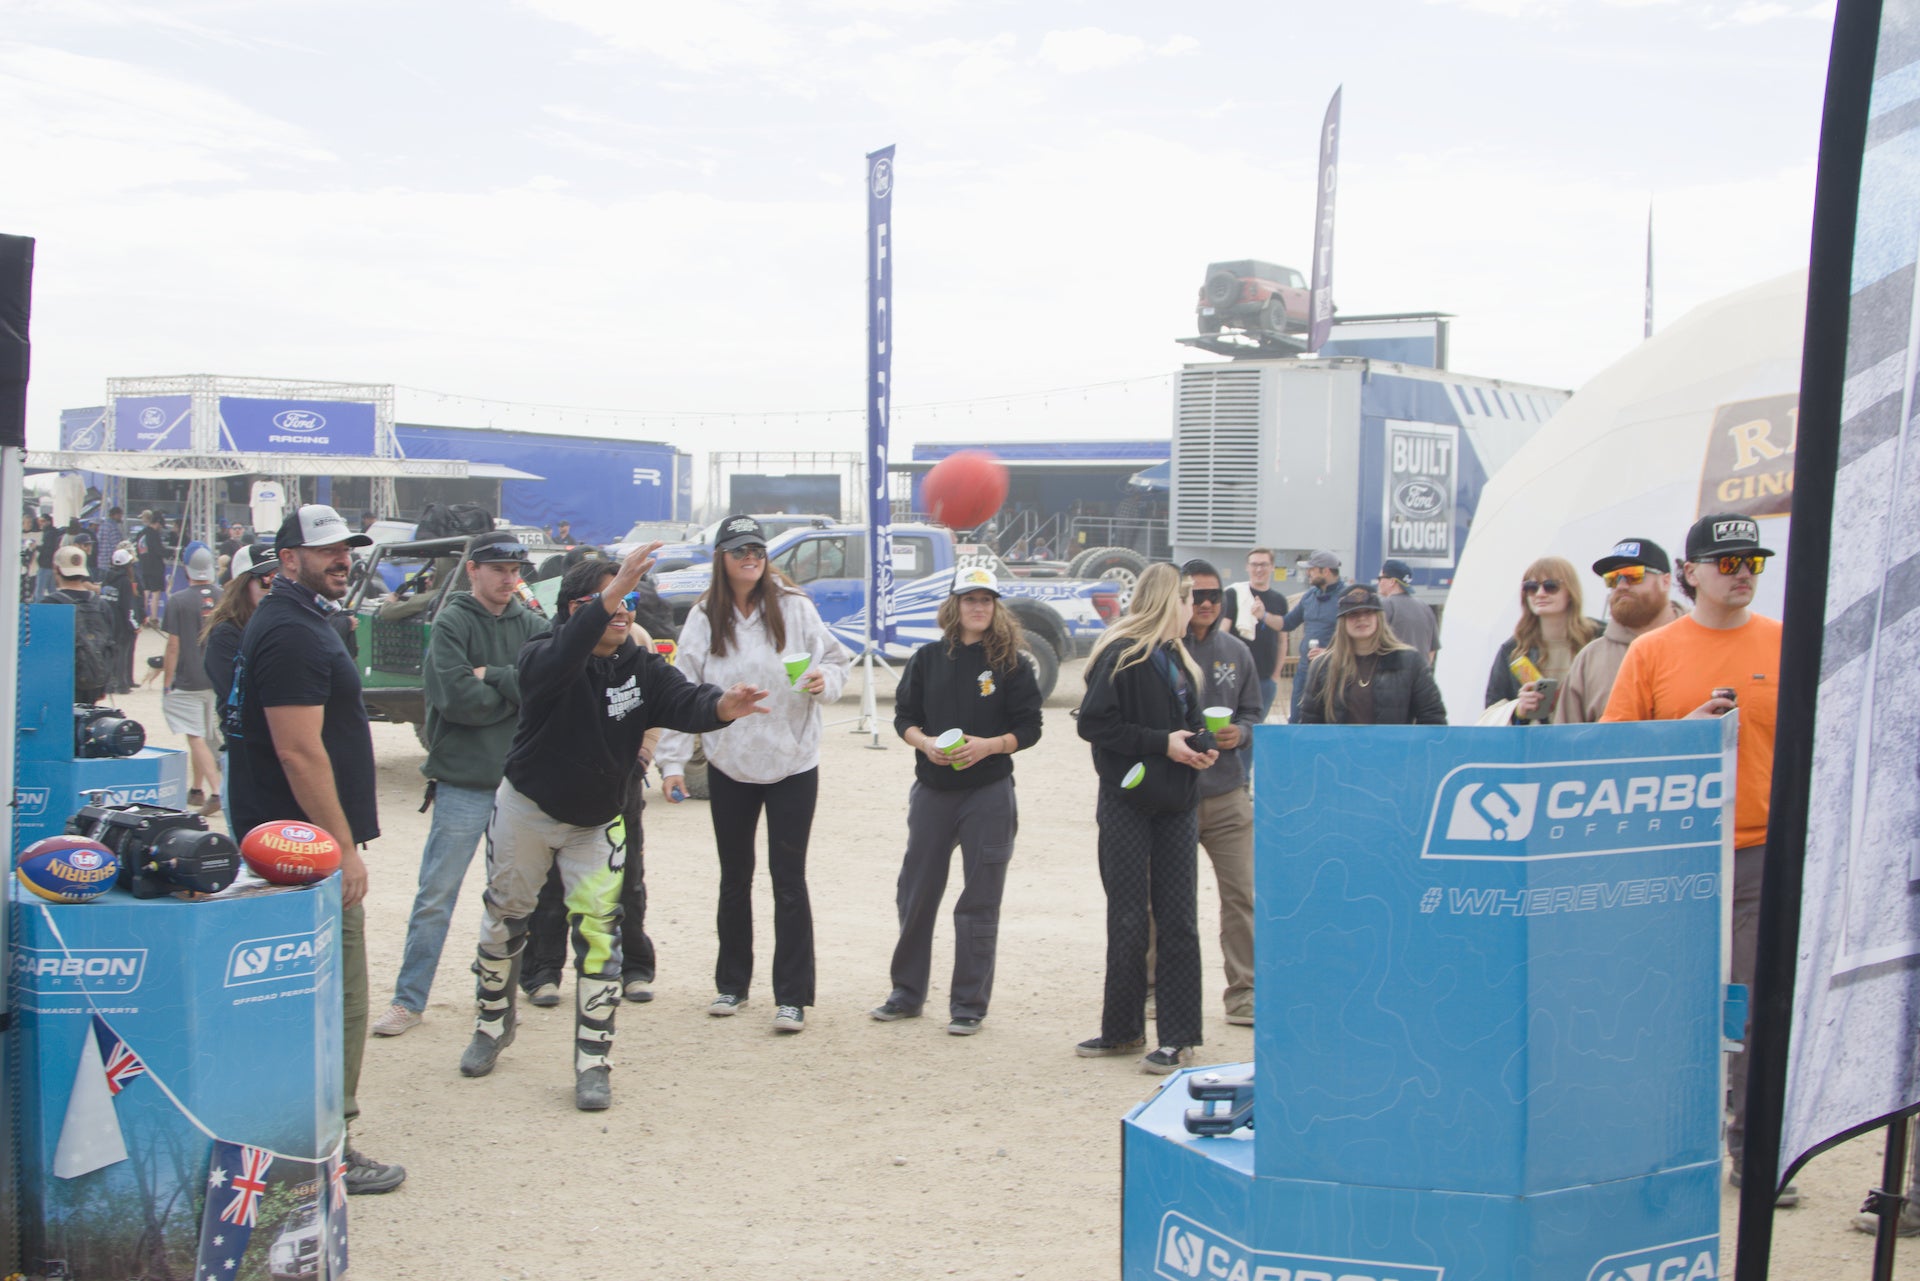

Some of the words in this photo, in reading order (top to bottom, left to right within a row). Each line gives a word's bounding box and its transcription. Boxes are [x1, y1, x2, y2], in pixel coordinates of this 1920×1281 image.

[282, 412, 317, 429] Ford
[269, 435, 329, 444] RACING
[1393, 436, 1450, 475] BUILT
[1405, 484, 1435, 508] Ford
[1391, 521, 1448, 550] TOUGH
[957, 554, 998, 573] 8135
[998, 585, 1081, 597] APTOR
[259, 832, 334, 854] SHERRIN
[46, 858, 117, 882] SHERRIN
[1420, 873, 1722, 917] #WHEREVERYO
[1656, 1251, 1720, 1281] CA
